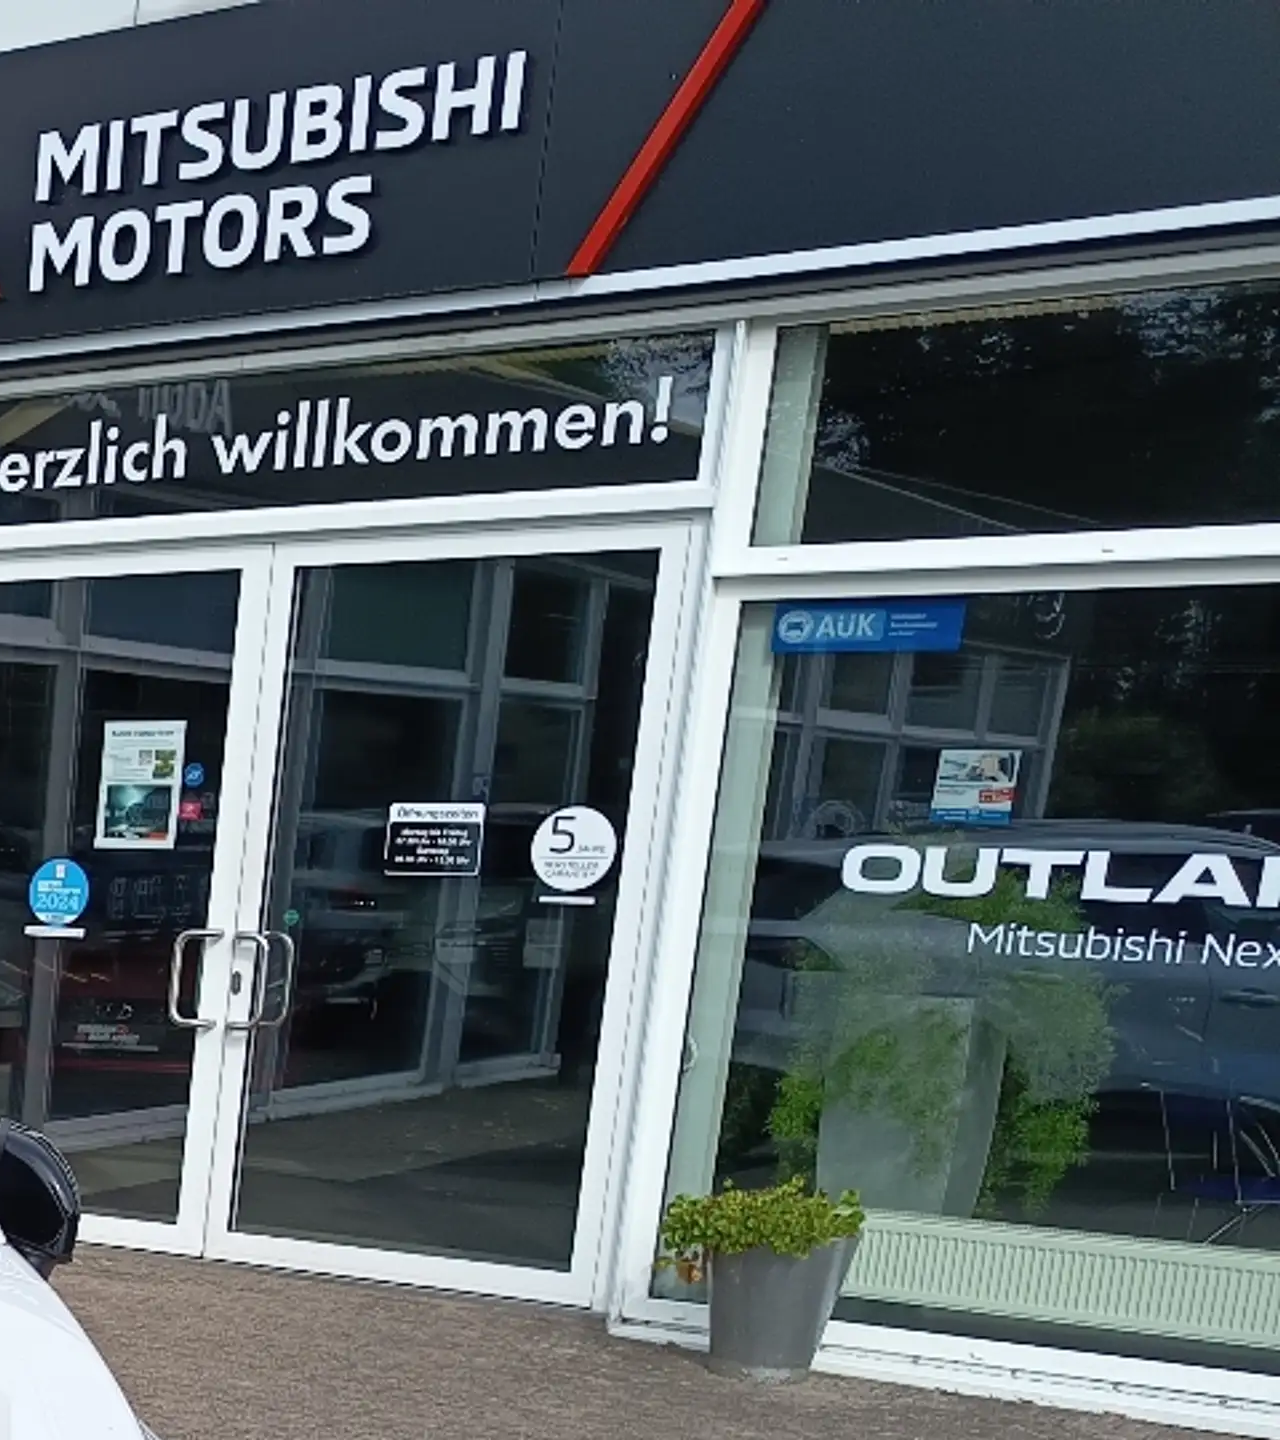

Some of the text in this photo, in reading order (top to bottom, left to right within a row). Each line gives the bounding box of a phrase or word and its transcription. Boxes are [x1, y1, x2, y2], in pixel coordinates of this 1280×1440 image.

[34, 49, 528, 202] MITSUBISHI
[28, 174, 374, 294] MOTORS
[213, 376, 675, 475] willkommen!
[549, 815, 577, 854] 5
[967, 921, 1188, 965] Mitsubishi
